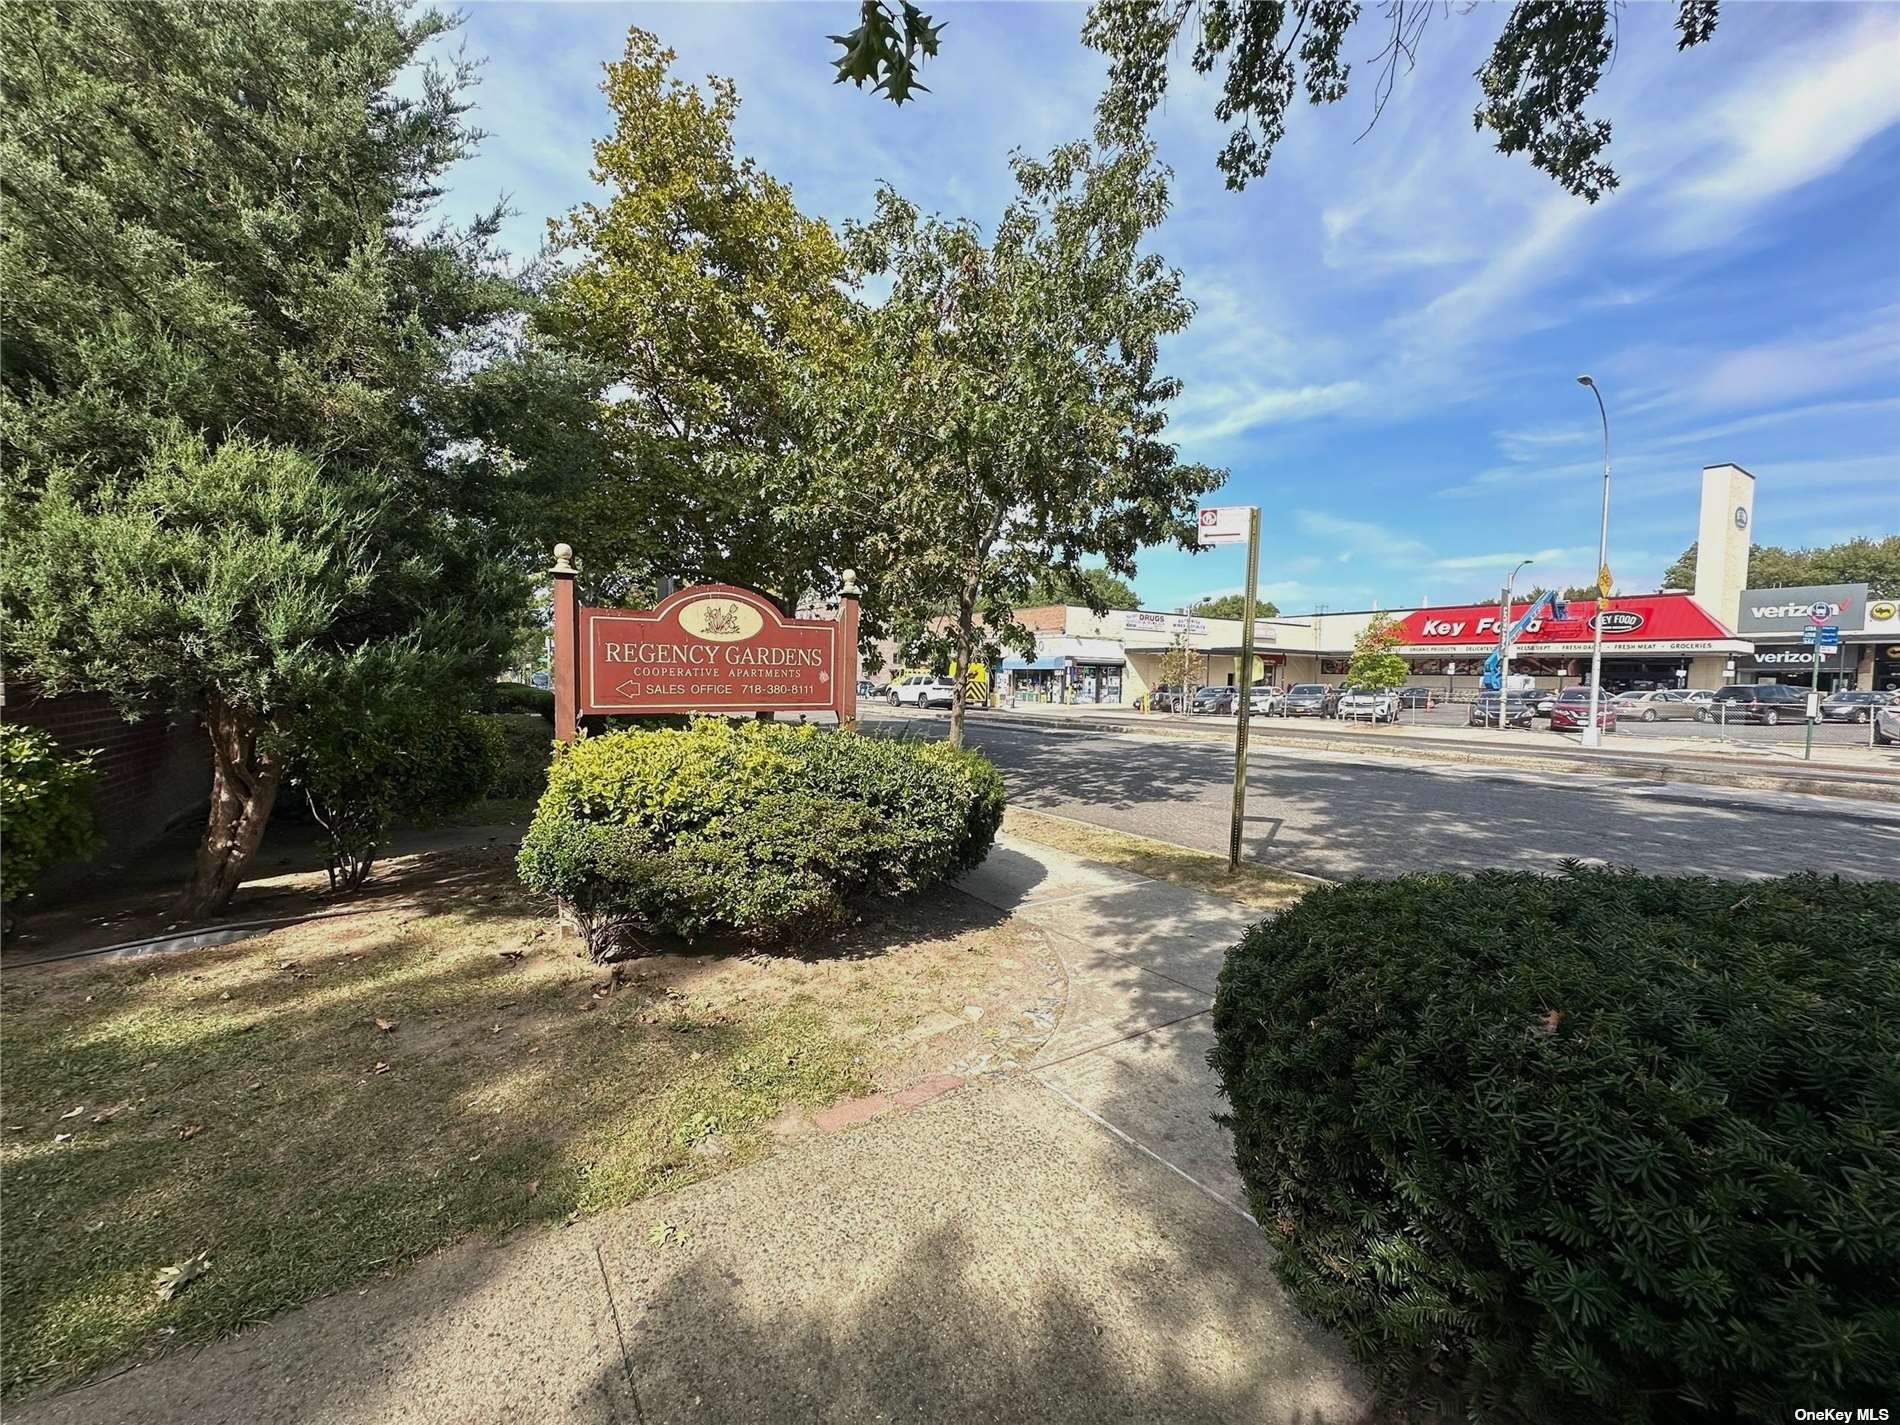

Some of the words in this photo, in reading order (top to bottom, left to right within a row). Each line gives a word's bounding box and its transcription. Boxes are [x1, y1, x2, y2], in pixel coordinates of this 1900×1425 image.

[1752, 603, 1840, 618] verizn
[1139, 613, 1165, 622] DRUGS
[1614, 614, 1637, 625] FOOD
[1422, 620, 1466, 637] Key
[1475, 617, 1543, 635] Fod
[605, 642, 720, 665] REGENCY
[725, 645, 823, 667] GARDENS
[1754, 651, 1826, 663] verizon
[633, 667, 720, 678] COOPERATIVE
[728, 668, 801, 678] APARTMENTS
[646, 684, 685, 695] SALES
[690, 684, 732, 695] OFFICE
[742, 684, 815, 696] 718-380-8111
